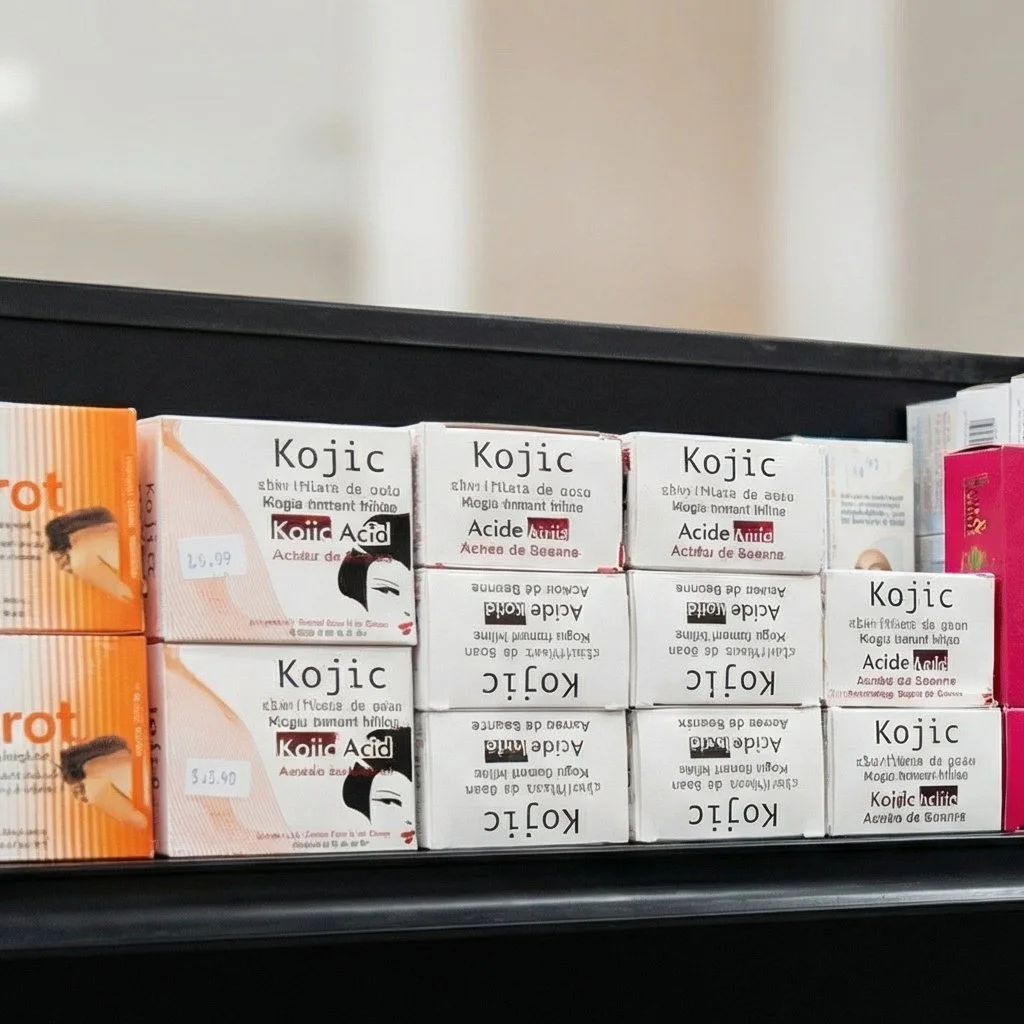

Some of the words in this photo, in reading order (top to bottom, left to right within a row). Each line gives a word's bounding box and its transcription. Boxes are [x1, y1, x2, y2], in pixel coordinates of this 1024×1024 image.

[274, 438, 385, 478] Kojic
[473, 441, 574, 477] Kojic
[683, 446, 777, 482] Kojic
[467, 518, 524, 538] Acide
[677, 522, 731, 541] Acide
[531, 603, 583, 621] Acide
[731, 604, 781, 622] Acide
[870, 580, 954, 614] Kojic
[278, 658, 387, 696] Kojic
[862, 653, 911, 670] Acide
[482, 665, 579, 701] Kojic
[531, 739, 584, 757] Acide
[733, 736, 782, 754] Acide
[875, 717, 960, 751] Kojic
[484, 802, 580, 838] Kojic
[688, 796, 778, 833] Kojic
